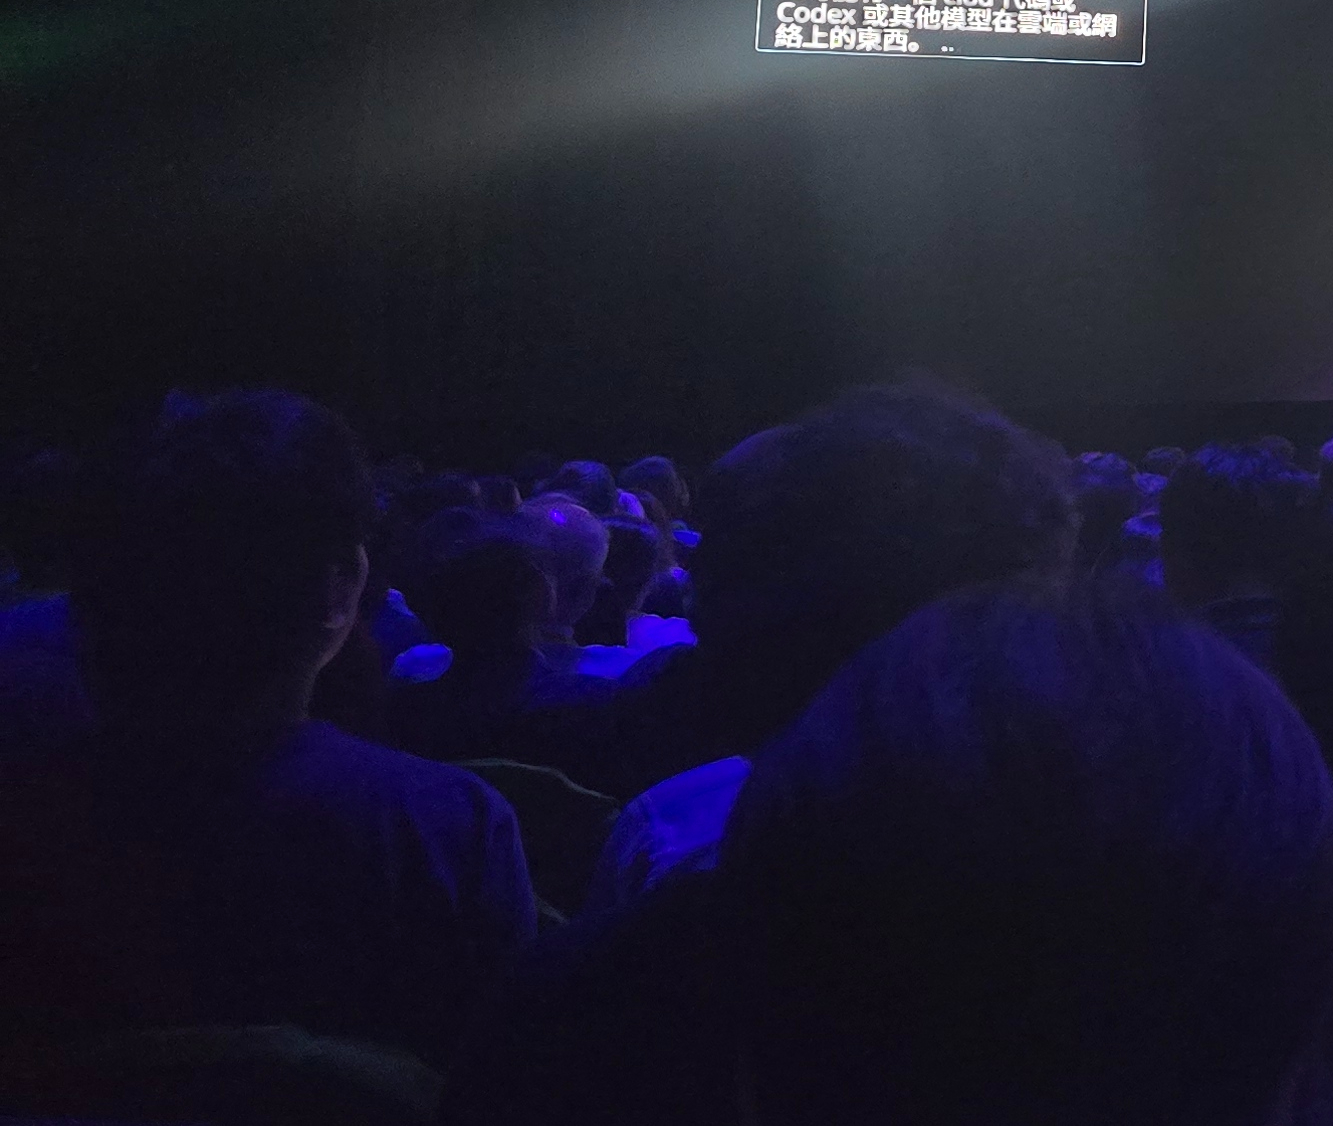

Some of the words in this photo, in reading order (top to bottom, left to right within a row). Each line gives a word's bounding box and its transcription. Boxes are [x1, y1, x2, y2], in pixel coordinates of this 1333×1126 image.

[776, 1, 857, 26] Codex
[862, 2, 1118, 38] 或其他模型在雲端或網
